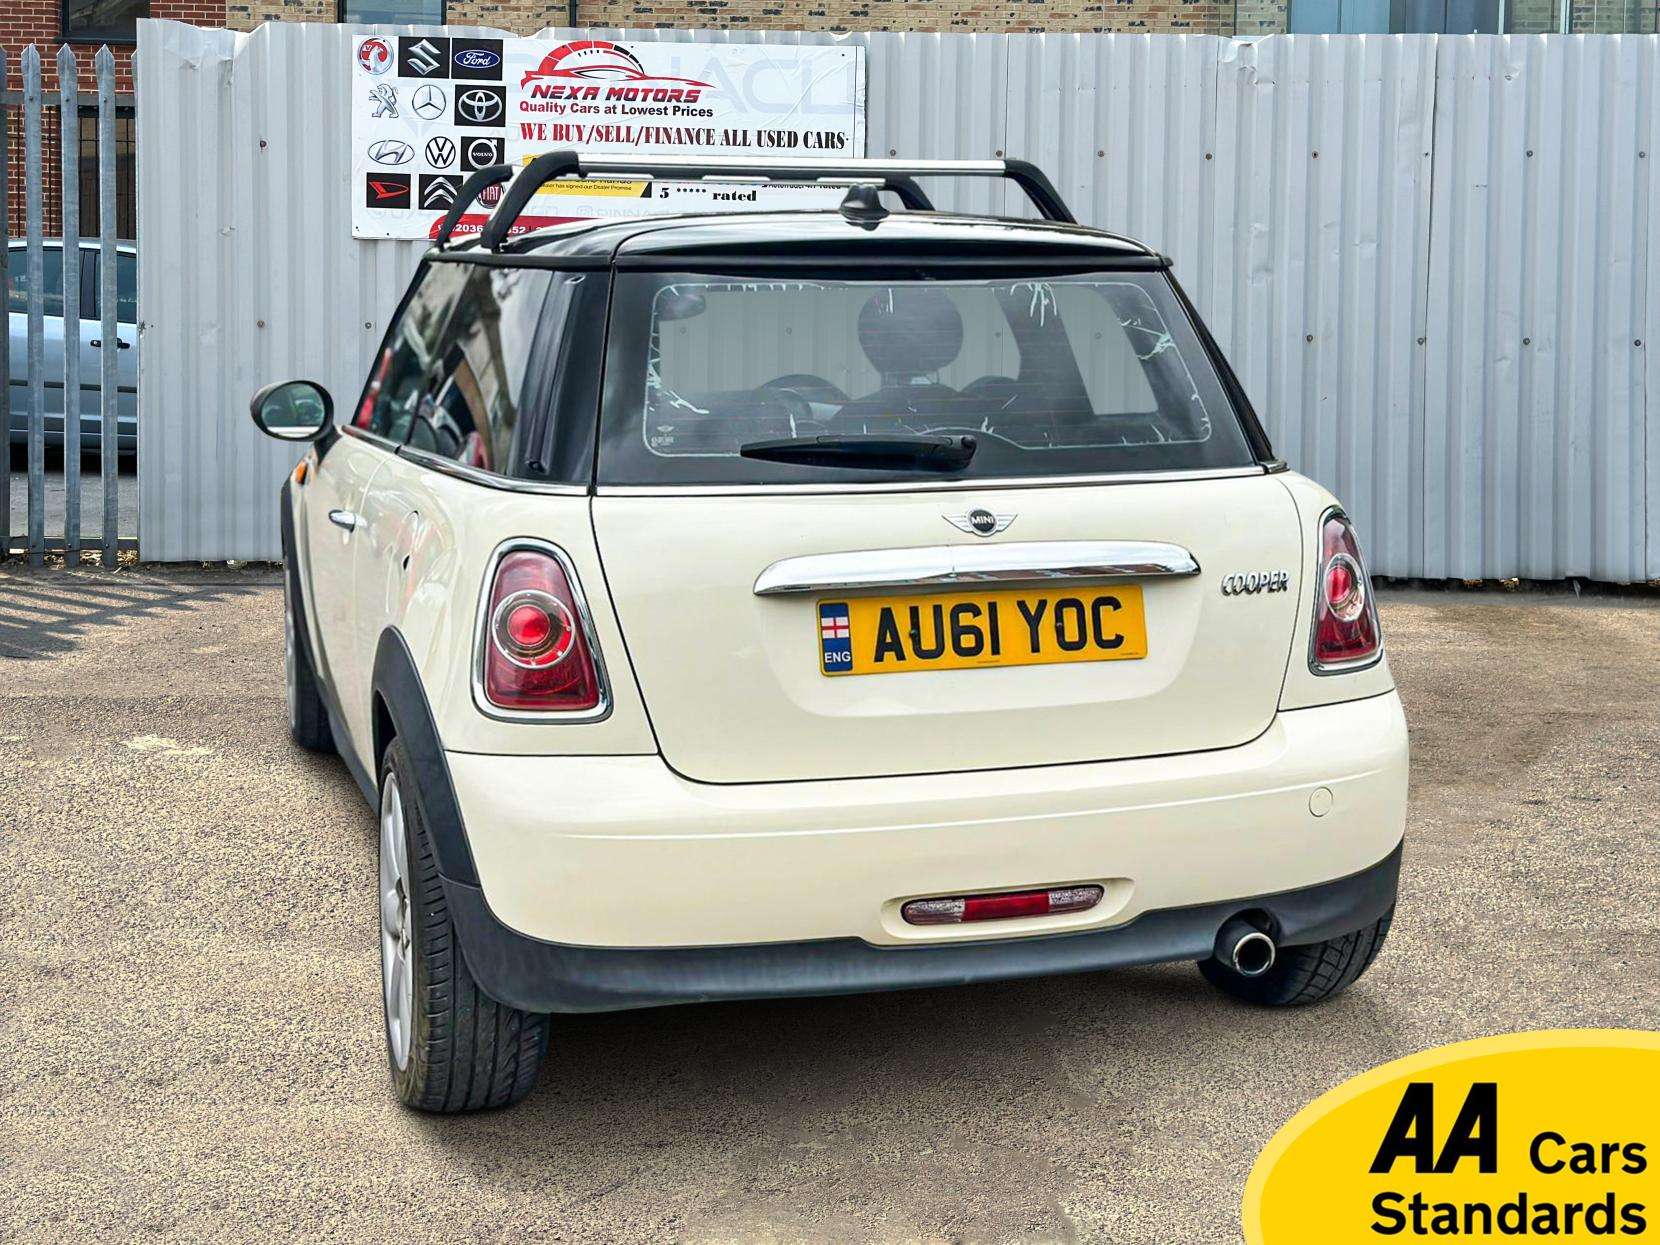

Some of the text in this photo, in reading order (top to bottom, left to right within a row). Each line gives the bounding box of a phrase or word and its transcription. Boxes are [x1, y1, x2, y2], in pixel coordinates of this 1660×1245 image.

[463, 52, 491, 66] Ford
[530, 84, 702, 103] NEXA MOTORS
[519, 101, 714, 117] Quality Cars at Lowest Prices
[520, 122, 845, 150] WE BUY/SELL/FINANCE ALL USED CARS
[472, 151, 493, 159] VOLVO
[659, 187, 757, 202] 5 rated
[971, 515, 994, 525] MINI
[1221, 570, 1288, 596] COOPER
[873, 595, 1125, 663] AU61 YOC
[824, 650, 851, 663] ENG
